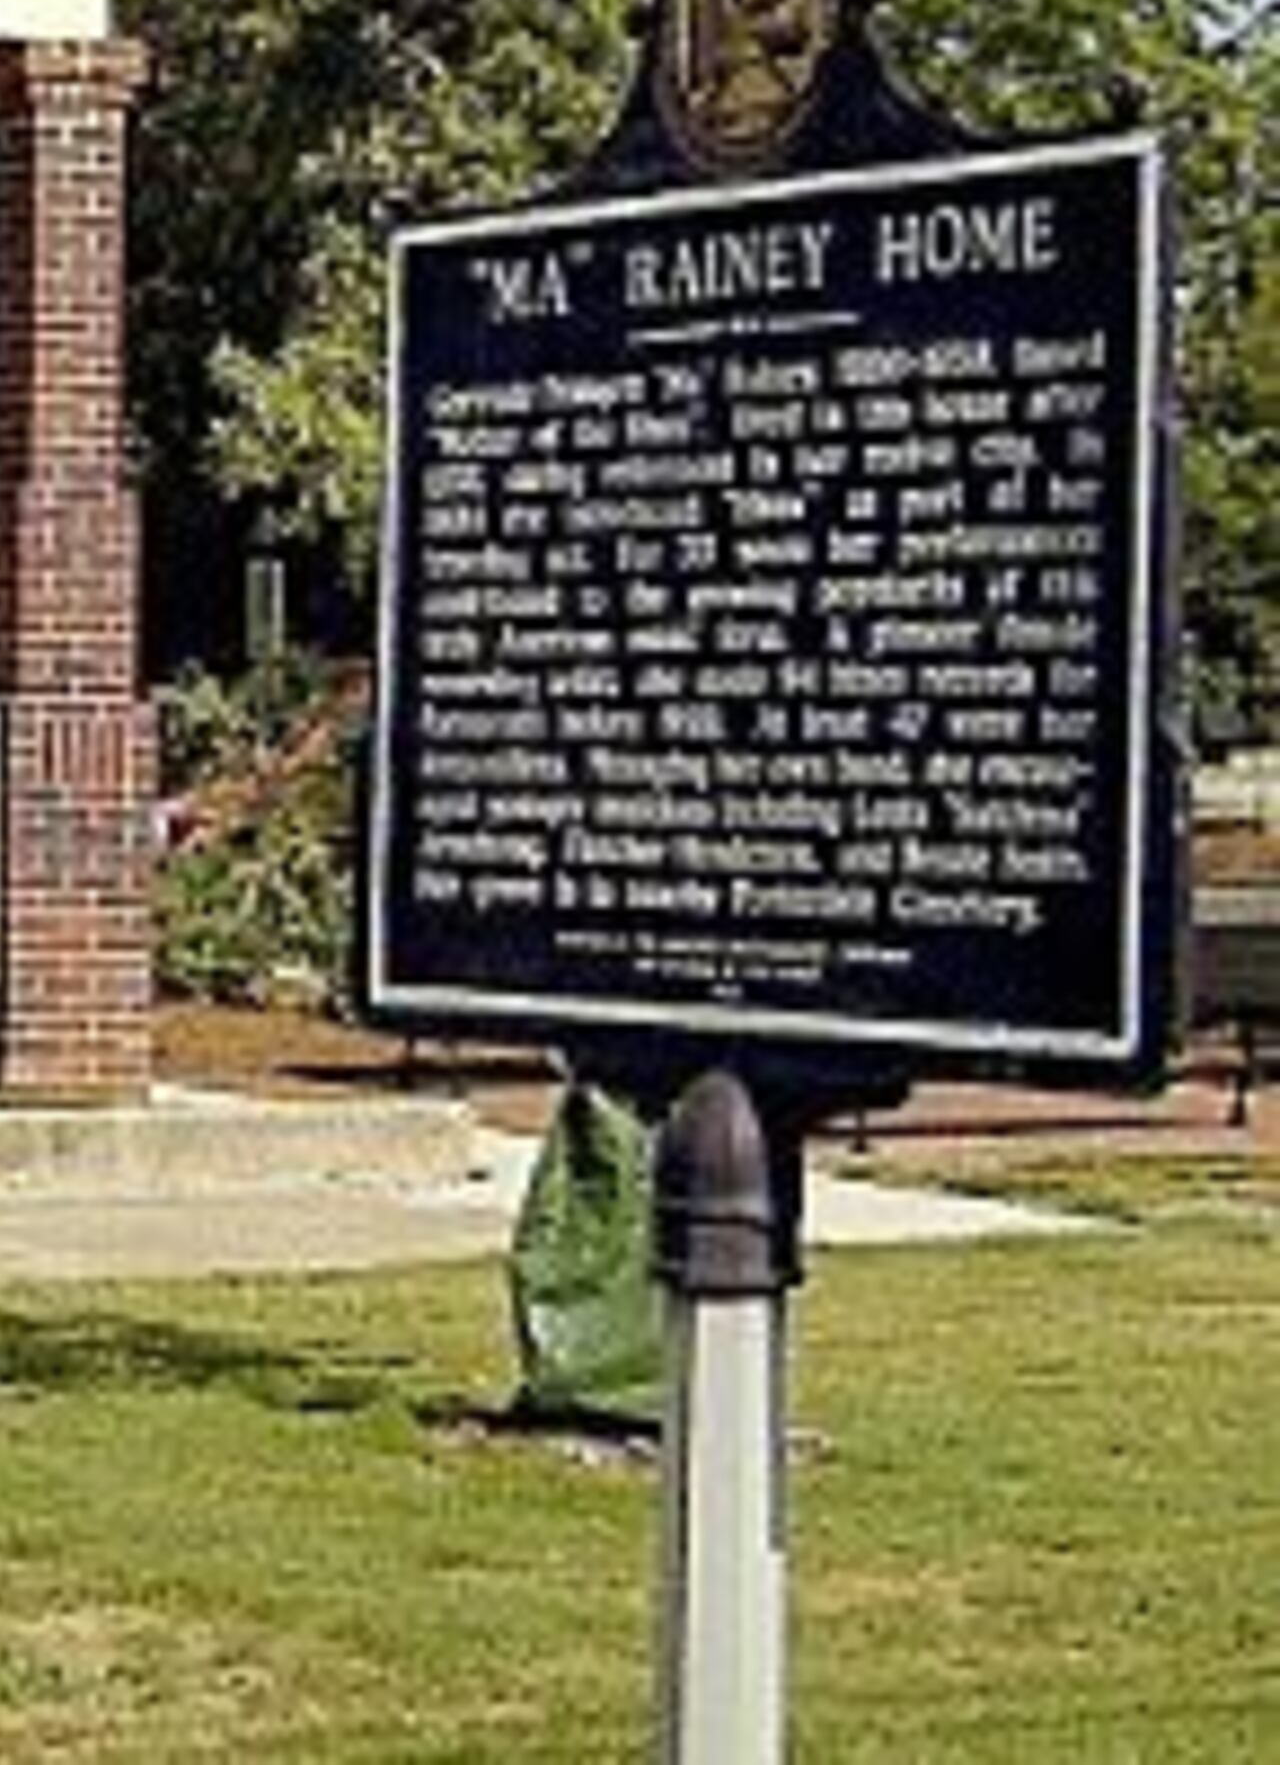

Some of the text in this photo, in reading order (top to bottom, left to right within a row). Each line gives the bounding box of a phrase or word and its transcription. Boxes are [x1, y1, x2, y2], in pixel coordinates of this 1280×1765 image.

[469, 197, 1059, 324] "MA" RAINEY HOME
